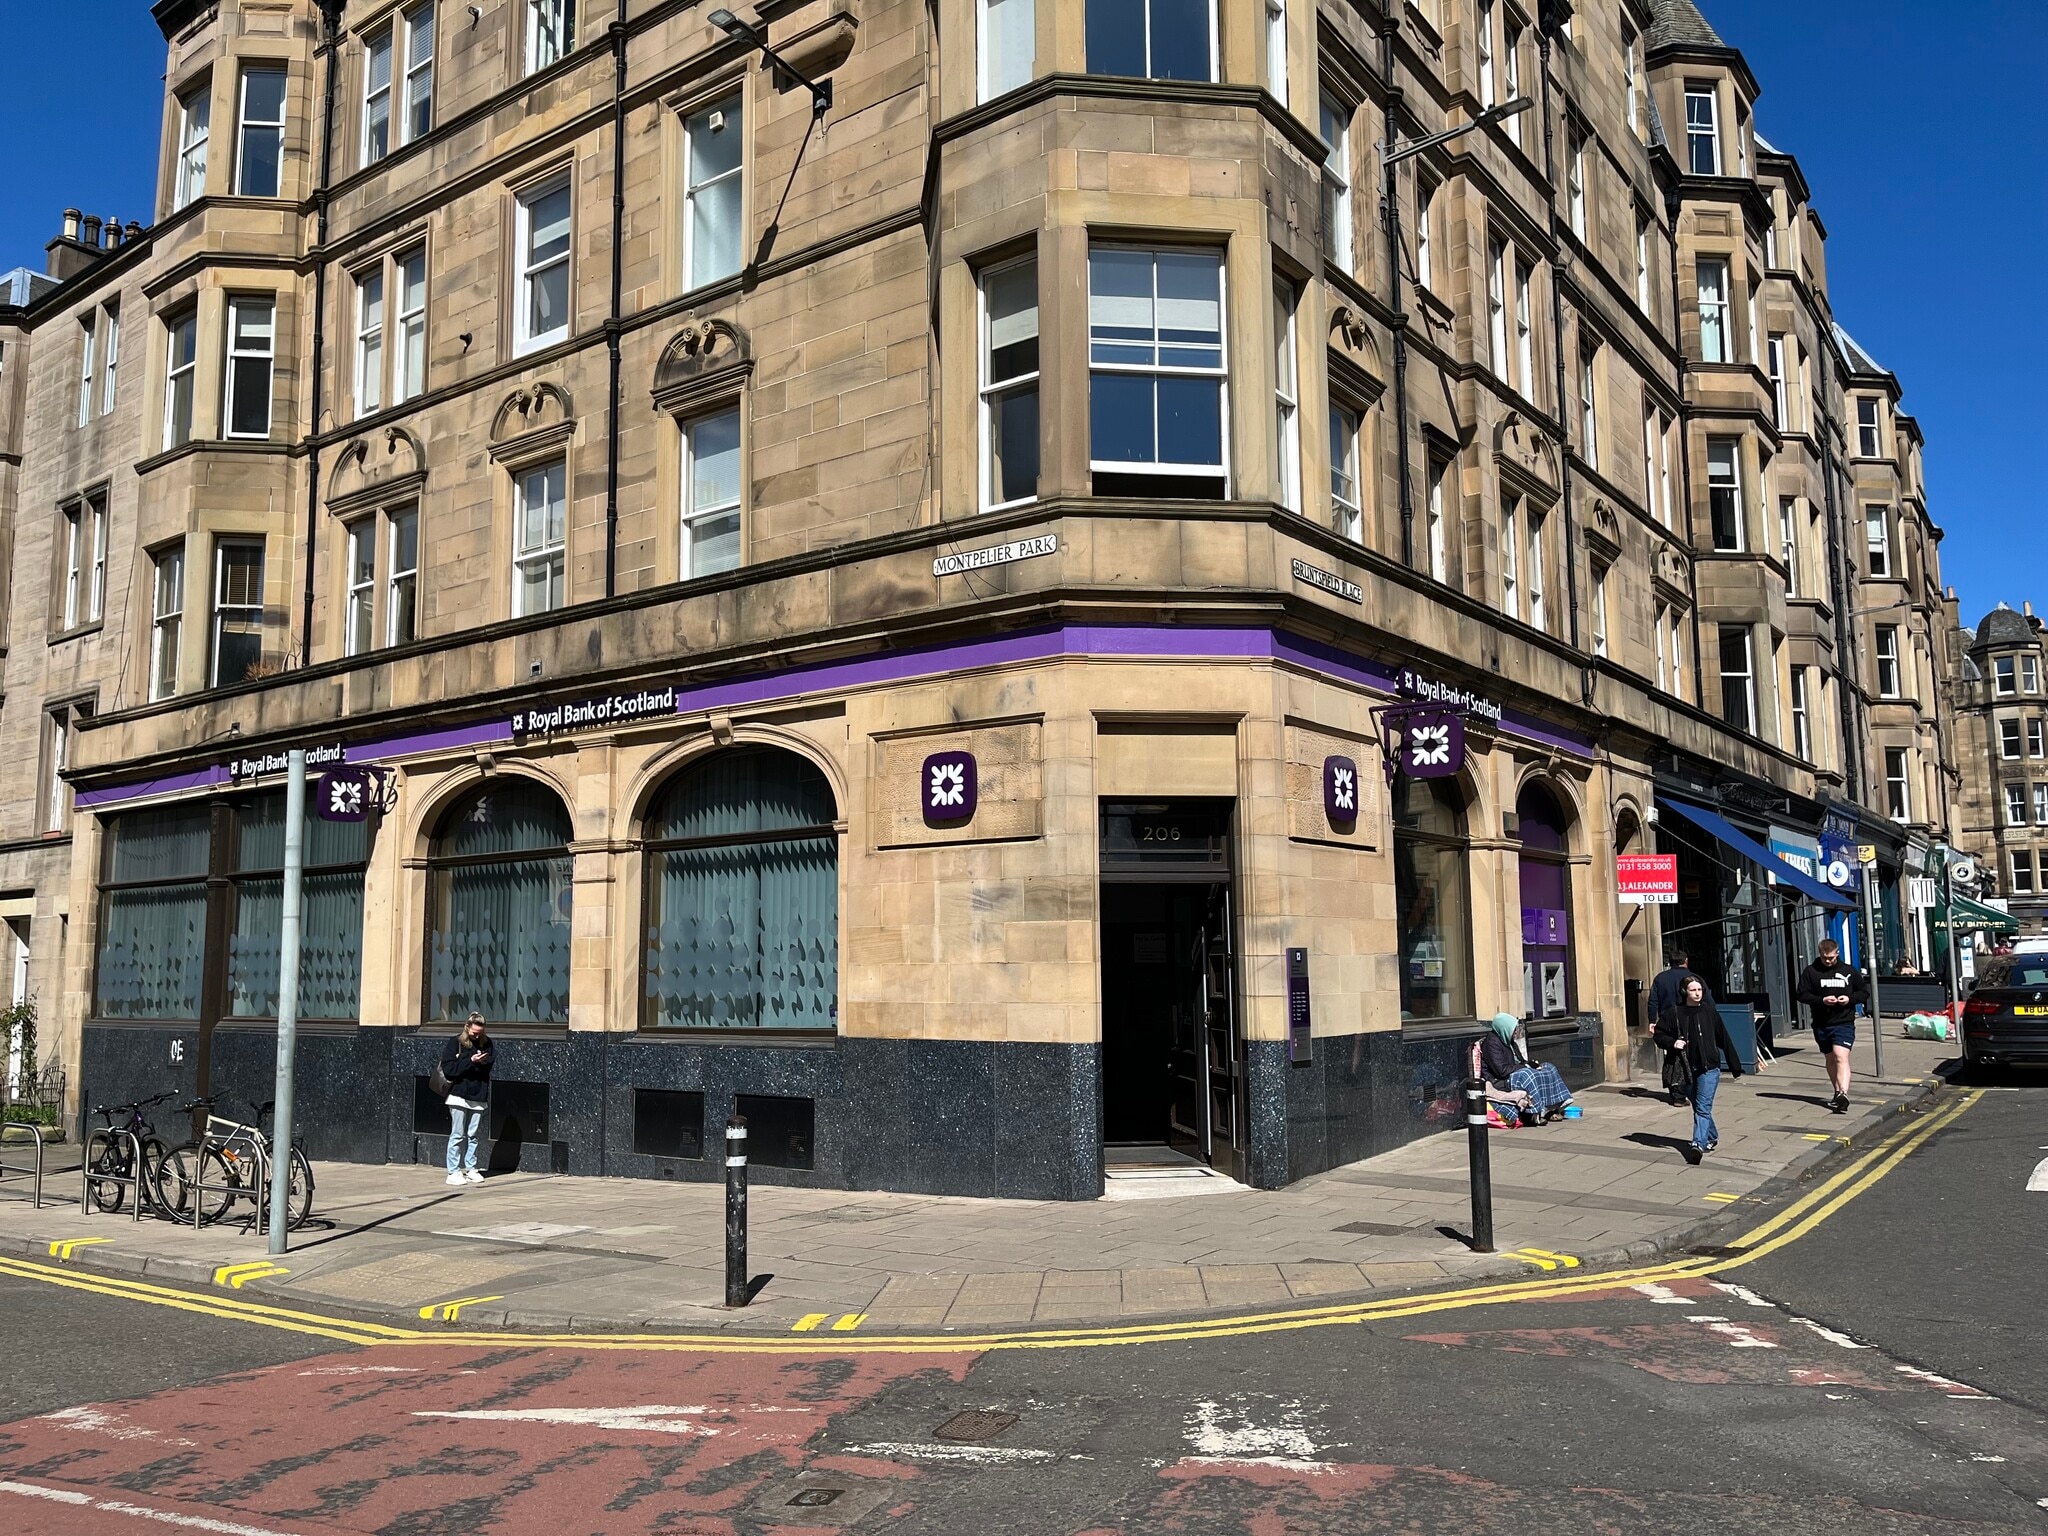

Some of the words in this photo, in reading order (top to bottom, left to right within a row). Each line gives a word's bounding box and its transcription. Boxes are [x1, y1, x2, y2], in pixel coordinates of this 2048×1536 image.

[936, 546, 1012, 574] MONTPELIER
[1019, 537, 1053, 557] PARK
[1295, 562, 1340, 591] BRUNTSFIELD
[1342, 581, 1361, 601] PLACE
[528, 706, 562, 732] Royal
[564, 701, 596, 725] Bank
[597, 697, 612, 719] of
[613, 687, 673, 717] Scotland
[1416, 674, 1440, 702] Royal
[1440, 683, 1460, 705] Bank
[1470, 694, 1502, 721] Scotland
[241, 756, 265, 777] Royal
[266, 752, 288, 771] Bank
[305, 743, 340, 764] cotland
[1143, 826, 1181, 841] 206
[1643, 894, 1655, 902] TO
[1657, 894, 1674, 902] LET
